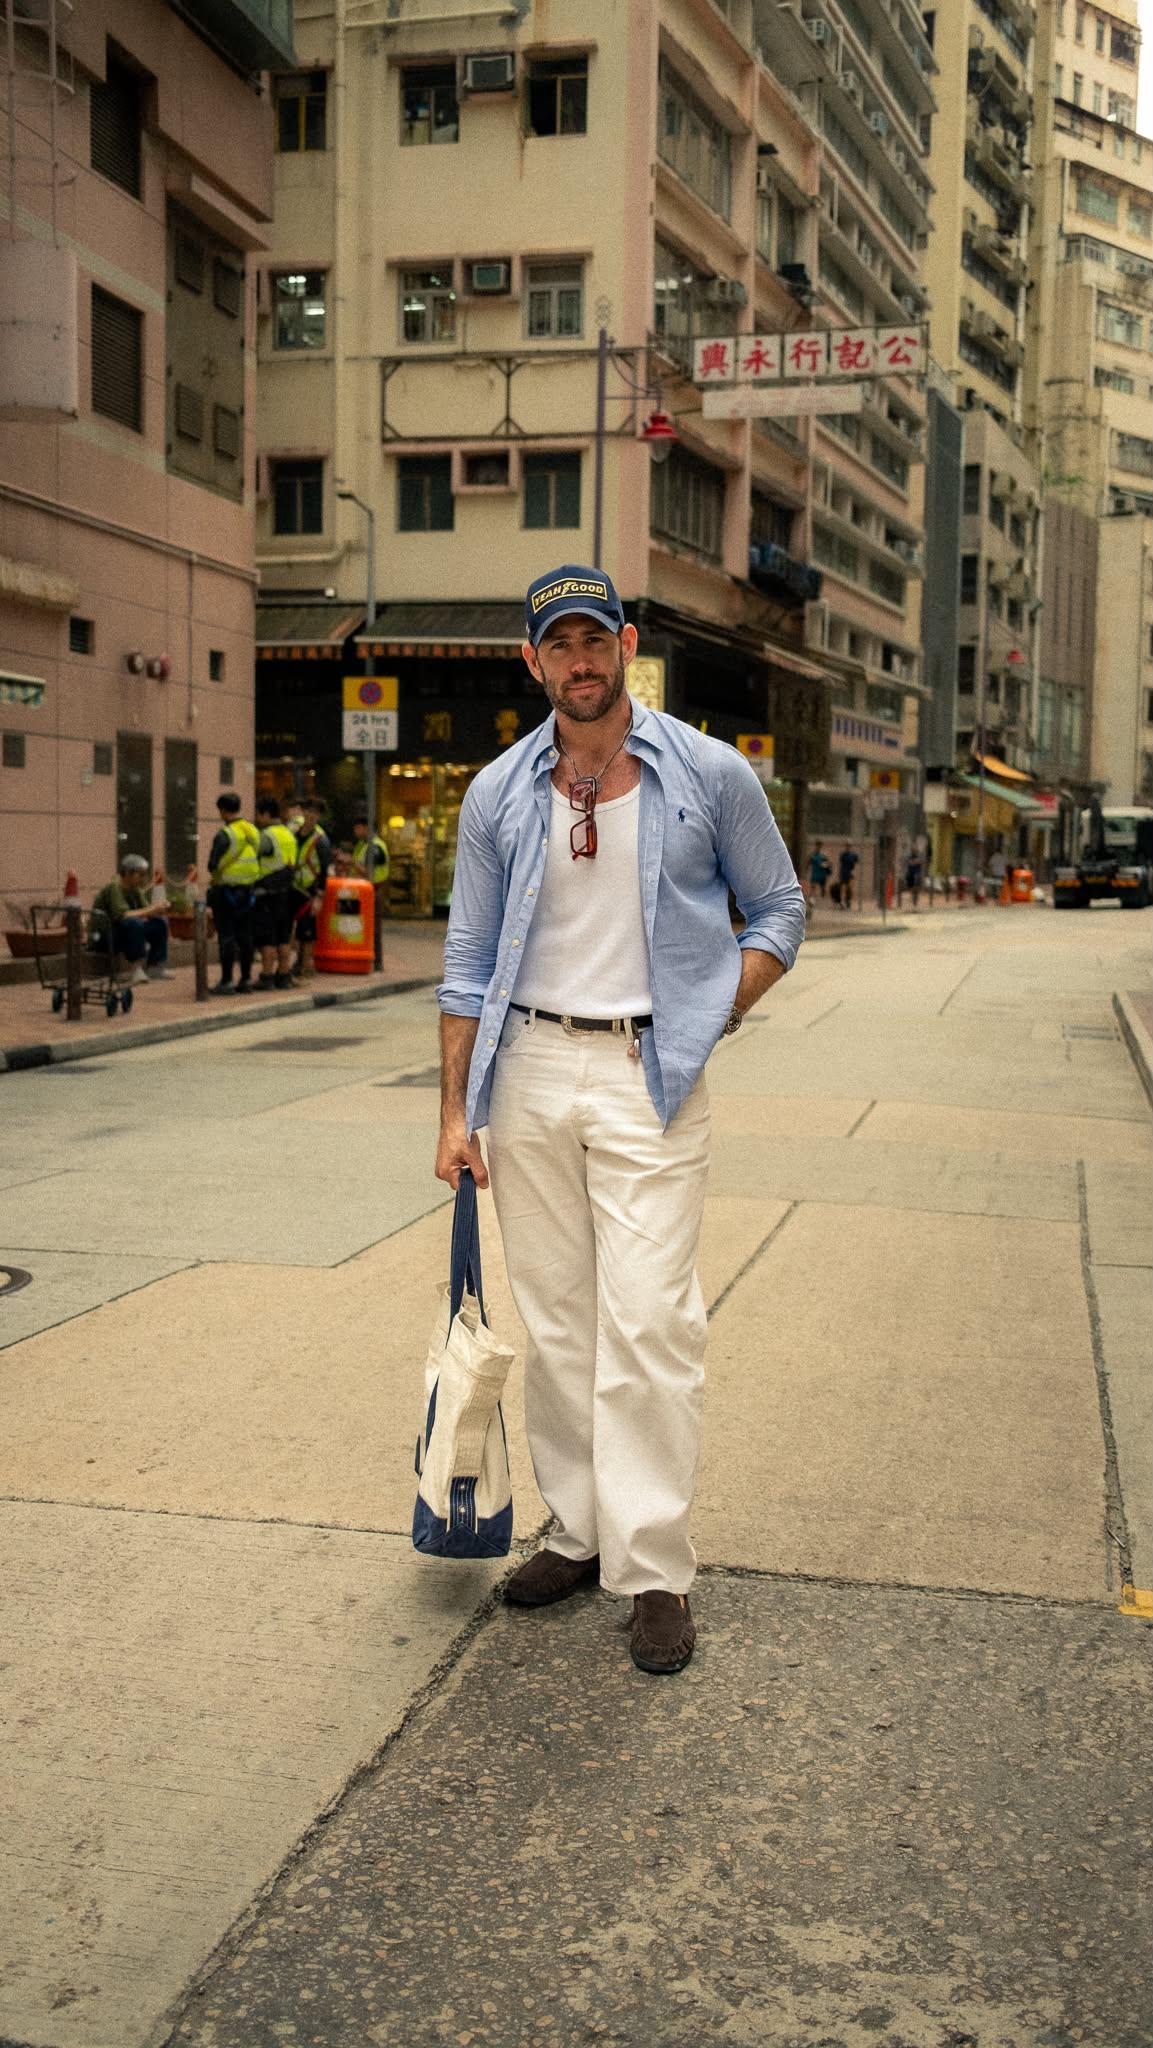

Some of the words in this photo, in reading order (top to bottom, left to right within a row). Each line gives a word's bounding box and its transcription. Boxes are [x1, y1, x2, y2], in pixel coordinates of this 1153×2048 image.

[535, 585, 562, 606] YEAH
[571, 583, 604, 594] GOOD
[352, 713, 368, 725] 24
[355, 728, 387, 746] 全日
